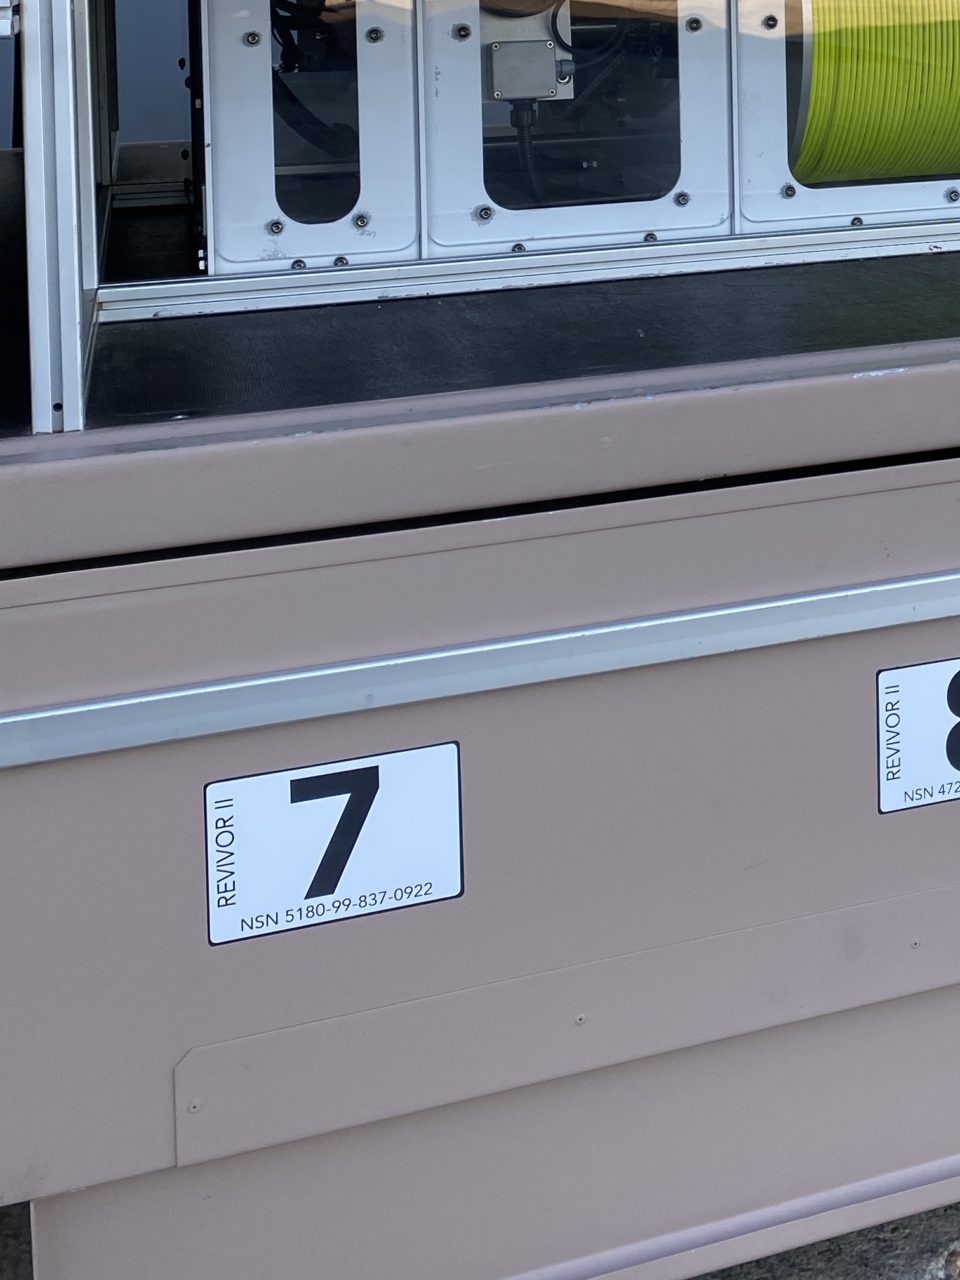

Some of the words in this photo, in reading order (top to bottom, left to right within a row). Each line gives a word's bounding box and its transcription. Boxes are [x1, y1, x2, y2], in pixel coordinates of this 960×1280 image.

[885, 684, 900, 695] II
[885, 700, 901, 781] REVIVOR
[214, 798, 234, 810] II
[904, 786, 934, 803] NSN
[289, 764, 380, 900] 7
[215, 815, 236, 908] REVIVOR
[240, 911, 279, 932] NSN
[284, 882, 434, 923] 5180-99-837-0922
